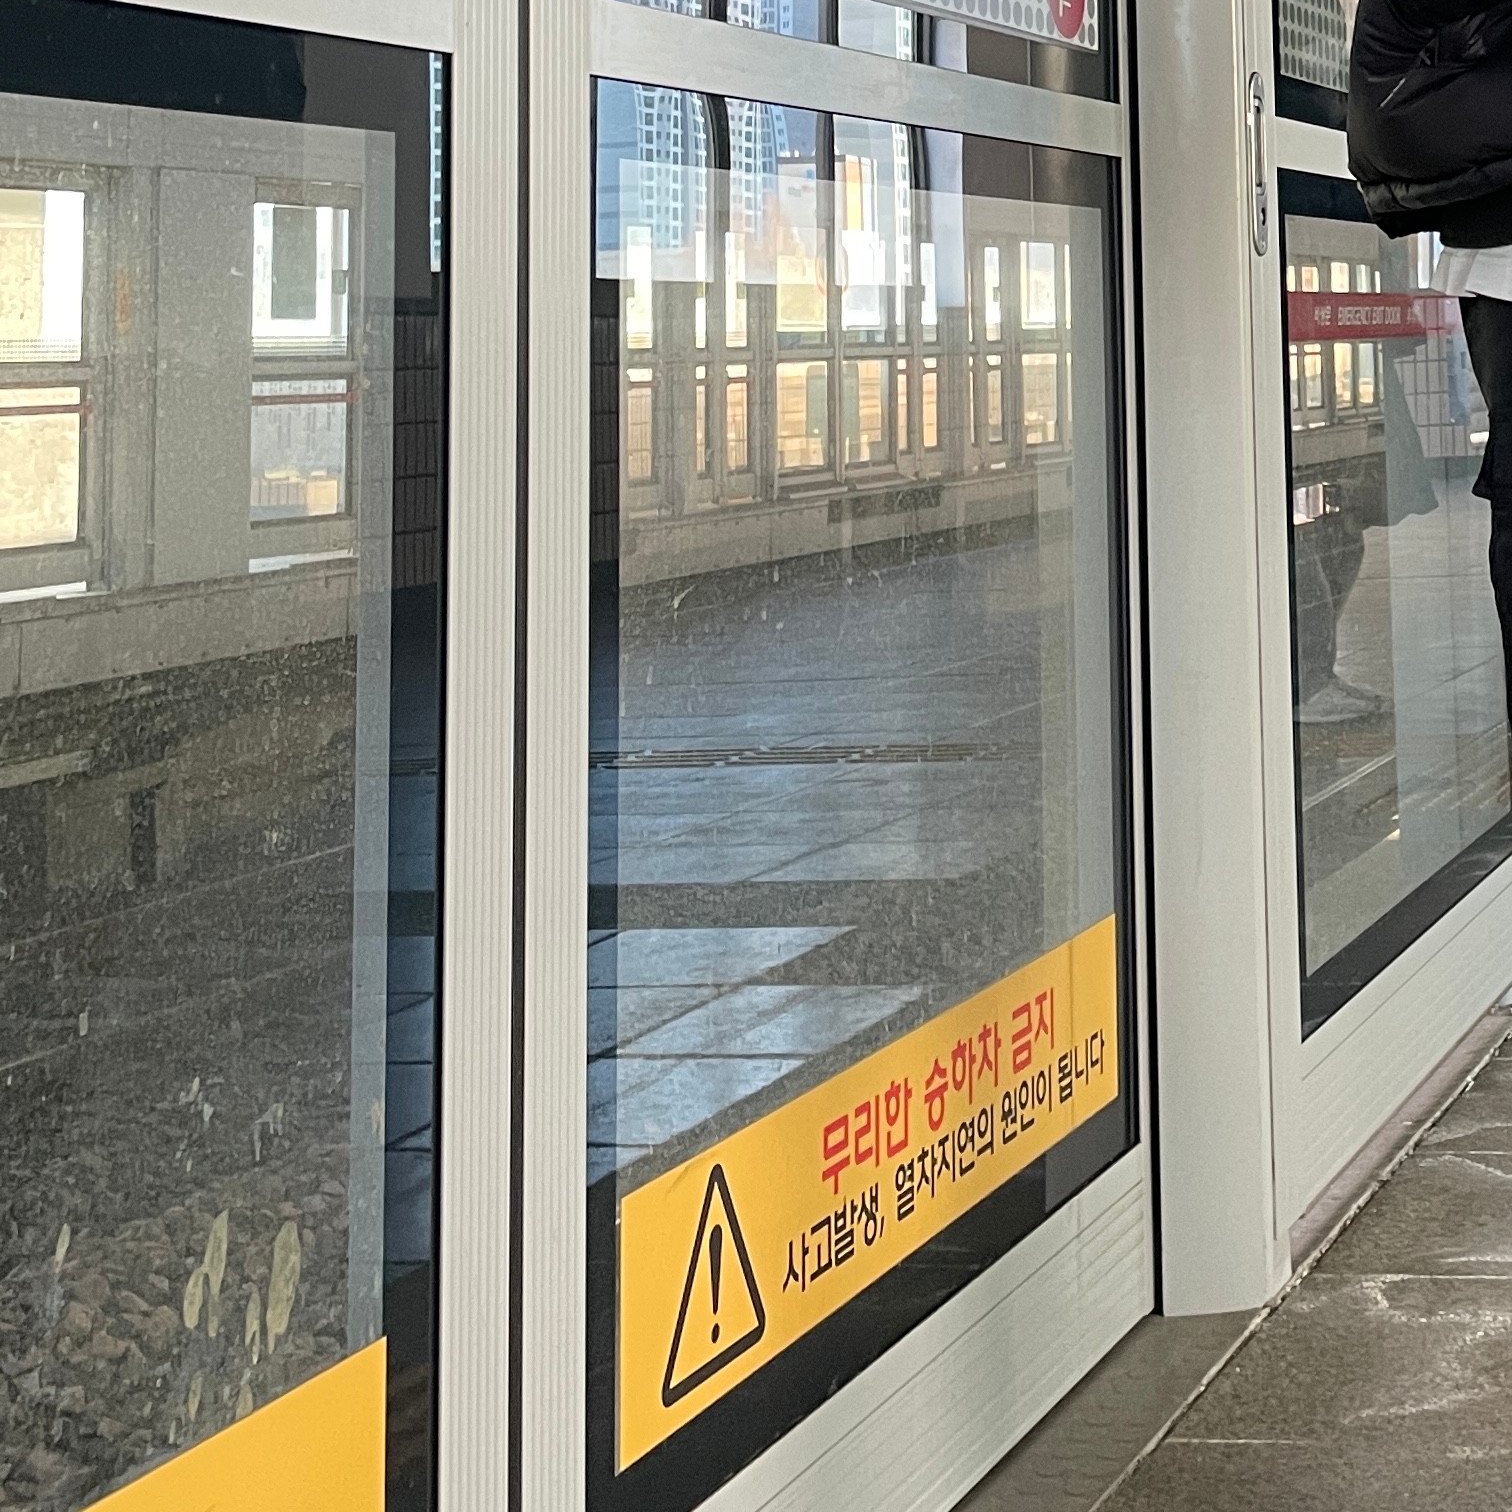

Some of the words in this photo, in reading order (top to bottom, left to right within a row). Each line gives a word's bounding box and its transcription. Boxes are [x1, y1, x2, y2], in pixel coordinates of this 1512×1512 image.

[782, 1182, 886, 1293] 사고발생,
[895, 1112, 995, 1223] 열차지연의
[1001, 1065, 1053, 1146] 원인이
[1058, 1028, 1105, 1105] 됩니다
[821, 1078, 913, 1195] 무리한
[924, 1024, 1002, 1132] 승하차
[1011, 987, 1055, 1074] 금지
